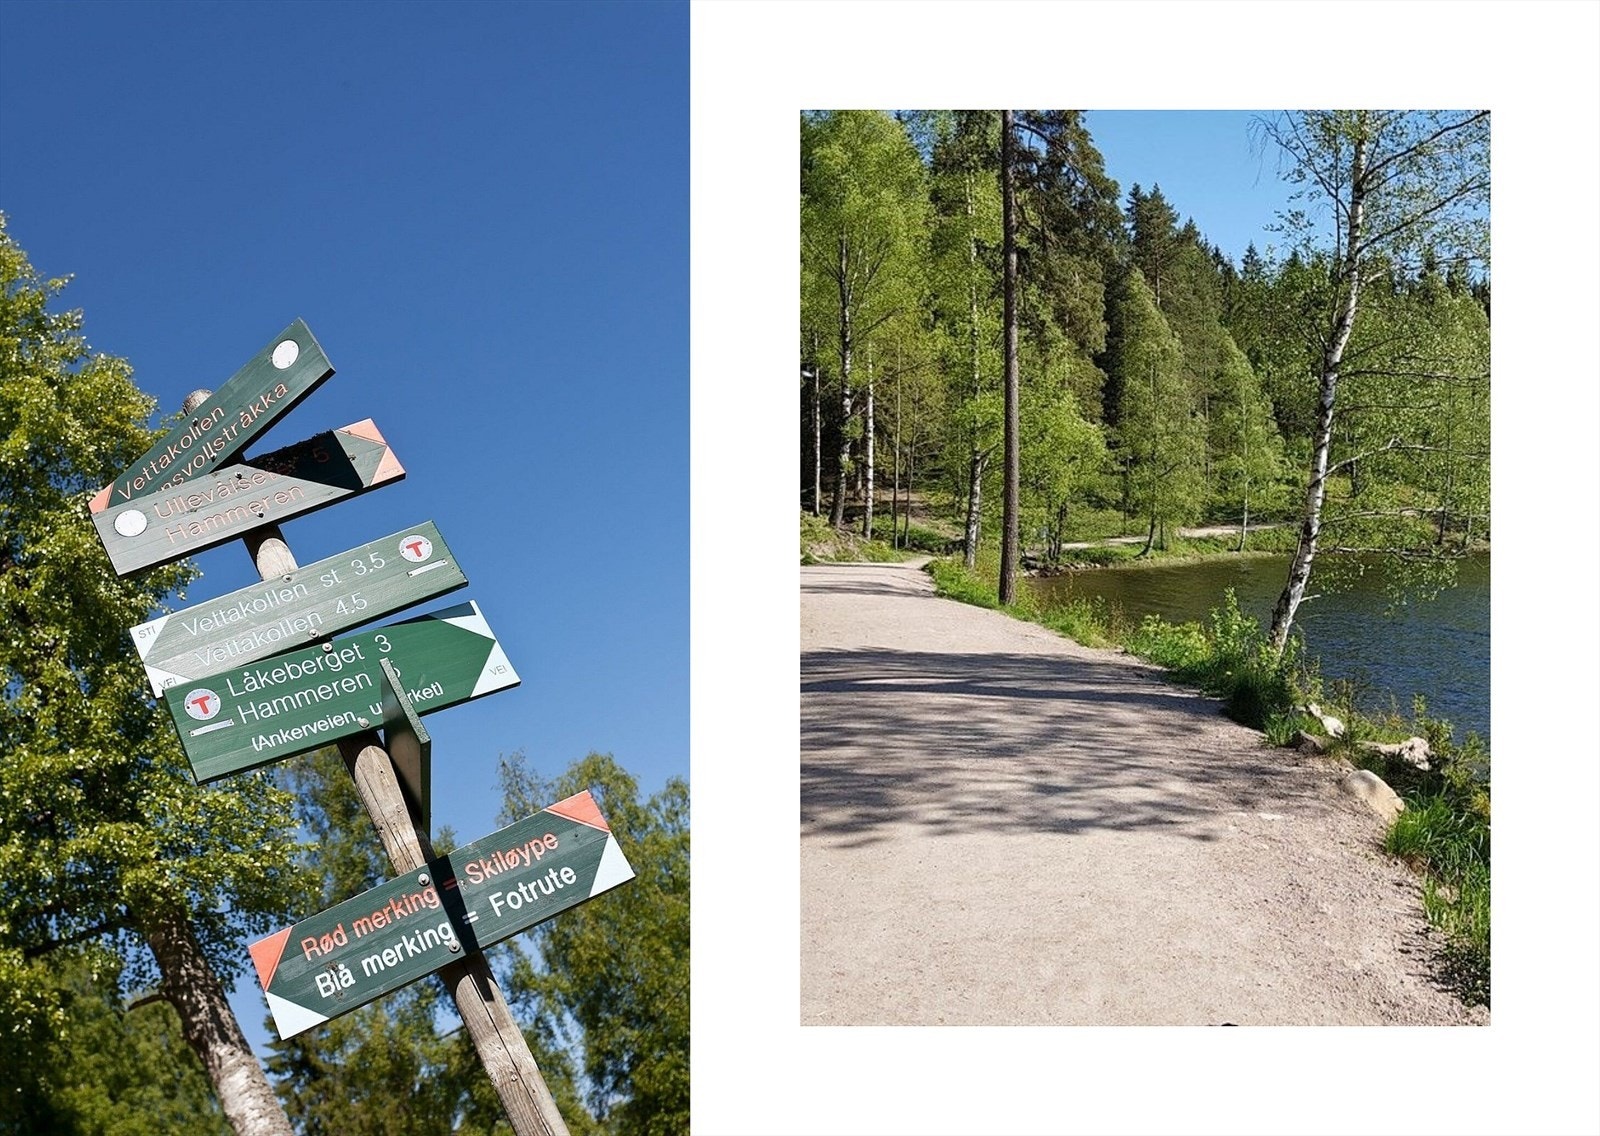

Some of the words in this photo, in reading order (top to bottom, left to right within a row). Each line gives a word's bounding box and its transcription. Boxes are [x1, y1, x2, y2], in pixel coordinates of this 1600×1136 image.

[165, 485, 305, 544] Hammeren
[181, 583, 308, 637] Vettakollen
[319, 568, 342, 589] st
[351, 551, 386, 577] 3,5
[138, 625, 157, 639] STI
[194, 611, 323, 667] Vettakollen
[335, 592, 368, 617] 4,5
[226, 643, 366, 698] Låkeberget
[374, 634, 393, 654] 3
[237, 671, 373, 725] Hammeren
[488, 664, 508, 676] VEI
[301, 922, 349, 962] Rød
[352, 886, 440, 939] merking
[464, 832, 560, 885] Skiløype
[314, 963, 356, 999] Blå
[361, 921, 457, 978] merking
[488, 866, 578, 918] Fotrute
